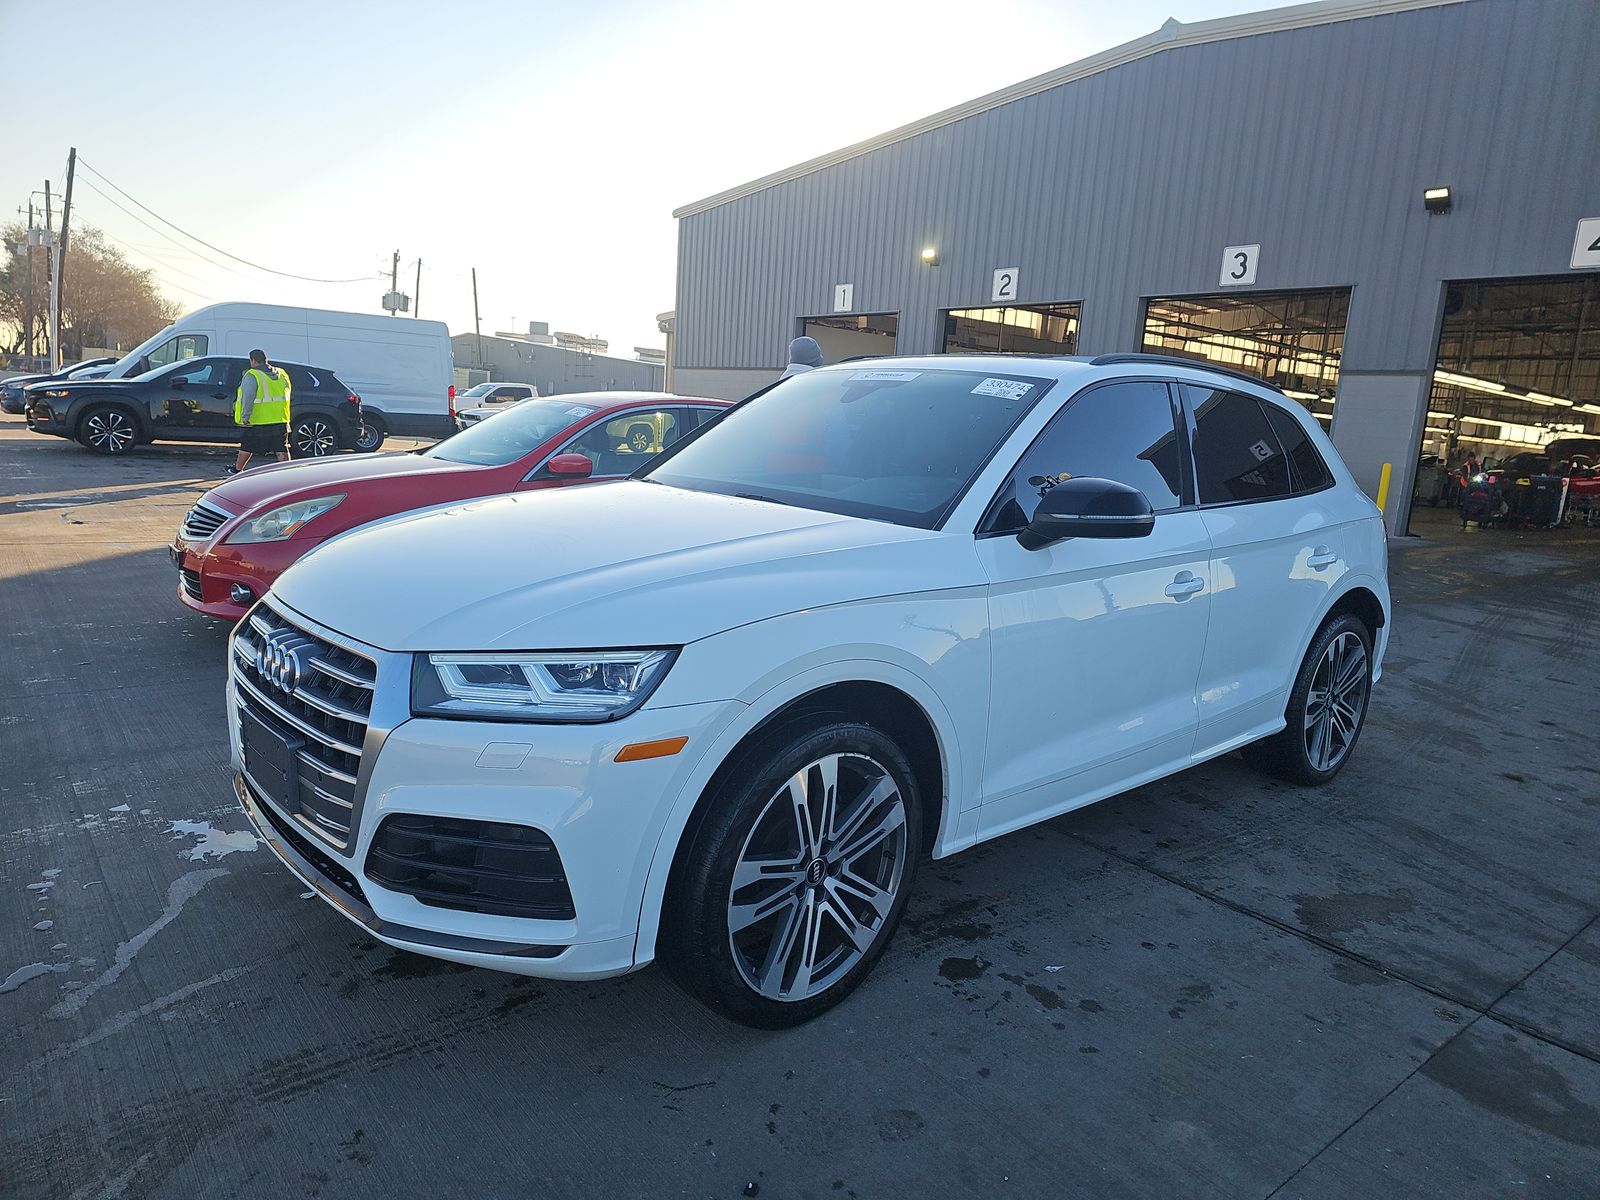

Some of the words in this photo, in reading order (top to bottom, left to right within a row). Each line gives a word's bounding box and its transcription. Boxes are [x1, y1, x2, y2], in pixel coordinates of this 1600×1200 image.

[1230, 252, 1248, 280] 3
[999, 273, 1012, 296] 2
[842, 288, 847, 308] 1
